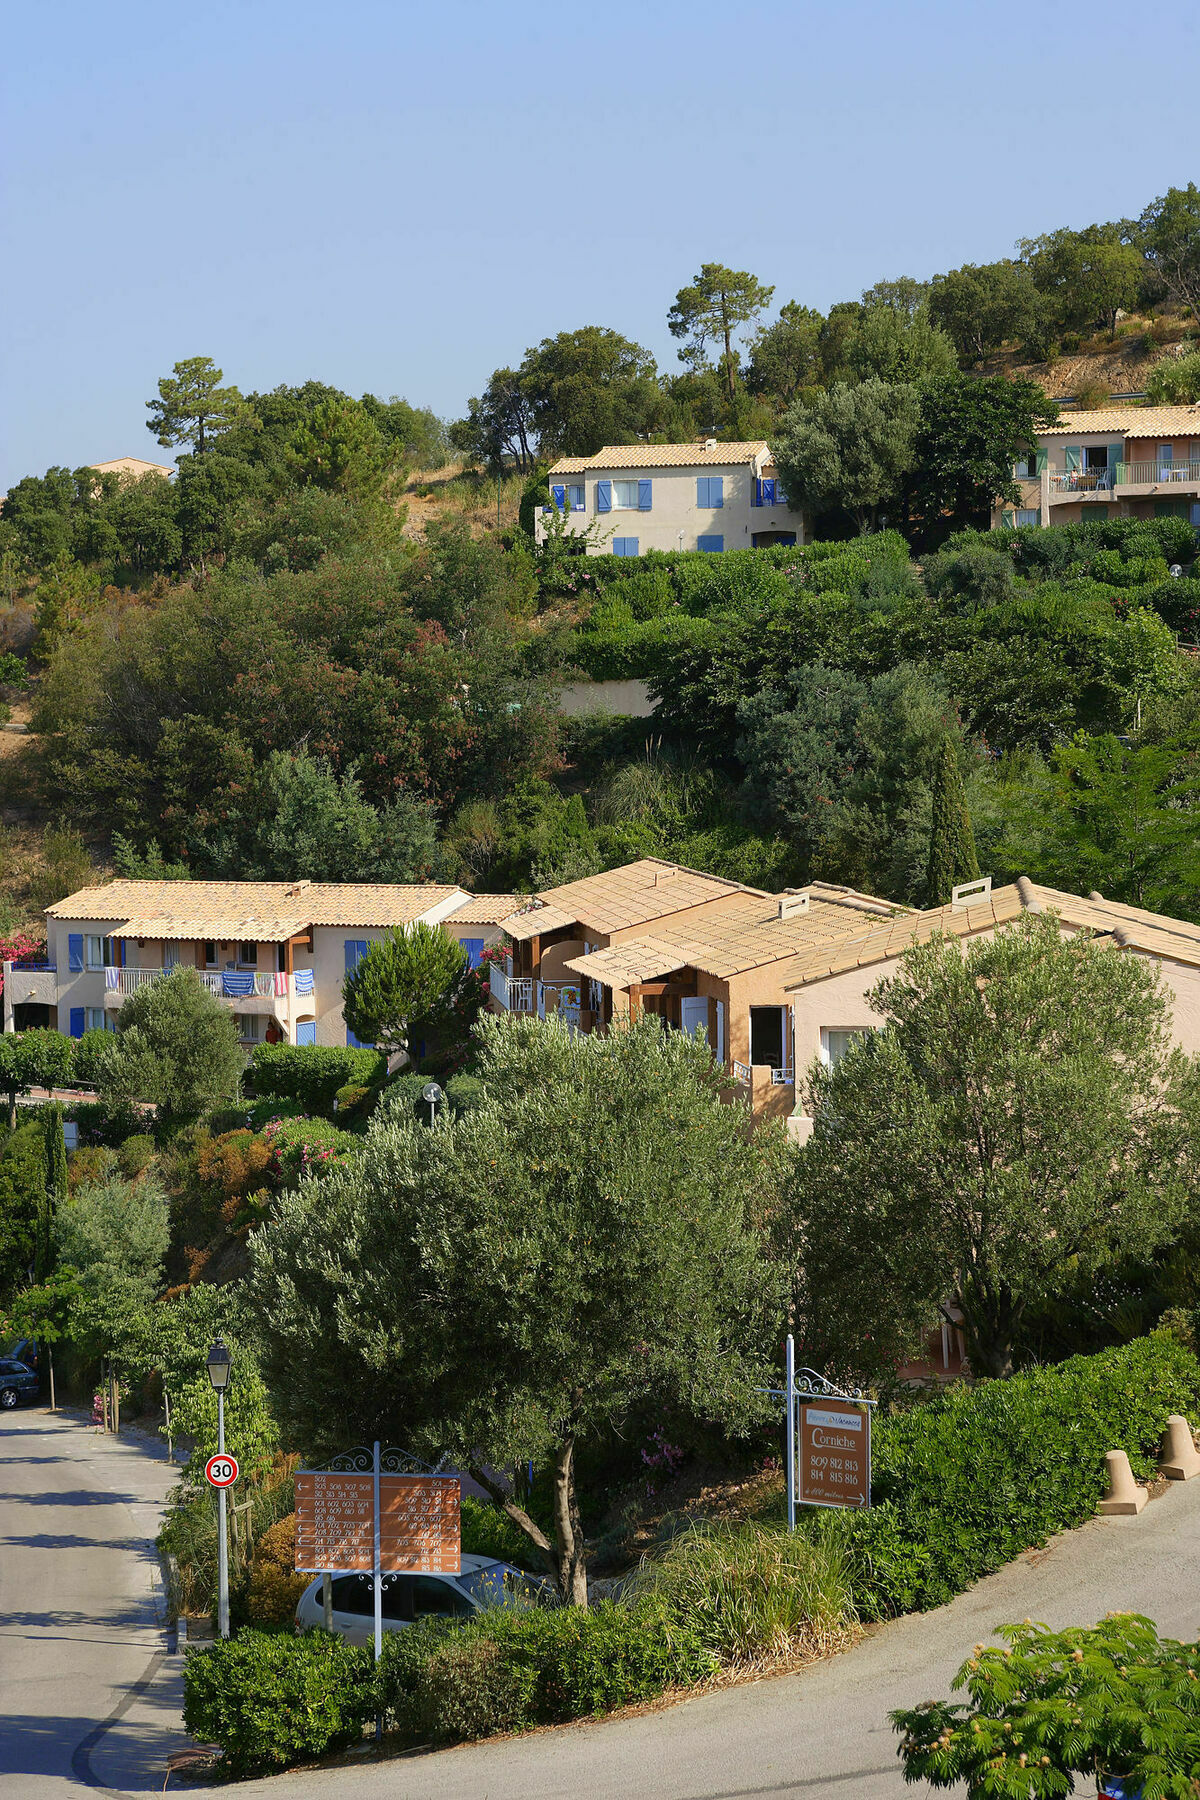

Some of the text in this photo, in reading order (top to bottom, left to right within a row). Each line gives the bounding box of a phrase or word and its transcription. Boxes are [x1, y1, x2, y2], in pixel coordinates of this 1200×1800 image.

[812, 1428, 856, 1449] Corniche
[810, 1455, 859, 1472] 809 812 813
[212, 1464, 232, 1478] 30
[810, 1469, 858, 1486] 814 815 816
[315, 1490, 323, 1498] 512
[330, 1507, 342, 1515] 609
[315, 1521, 324, 1529] 701
[358, 1522, 370, 1530] 704
[397, 1556, 409, 1564] 809
